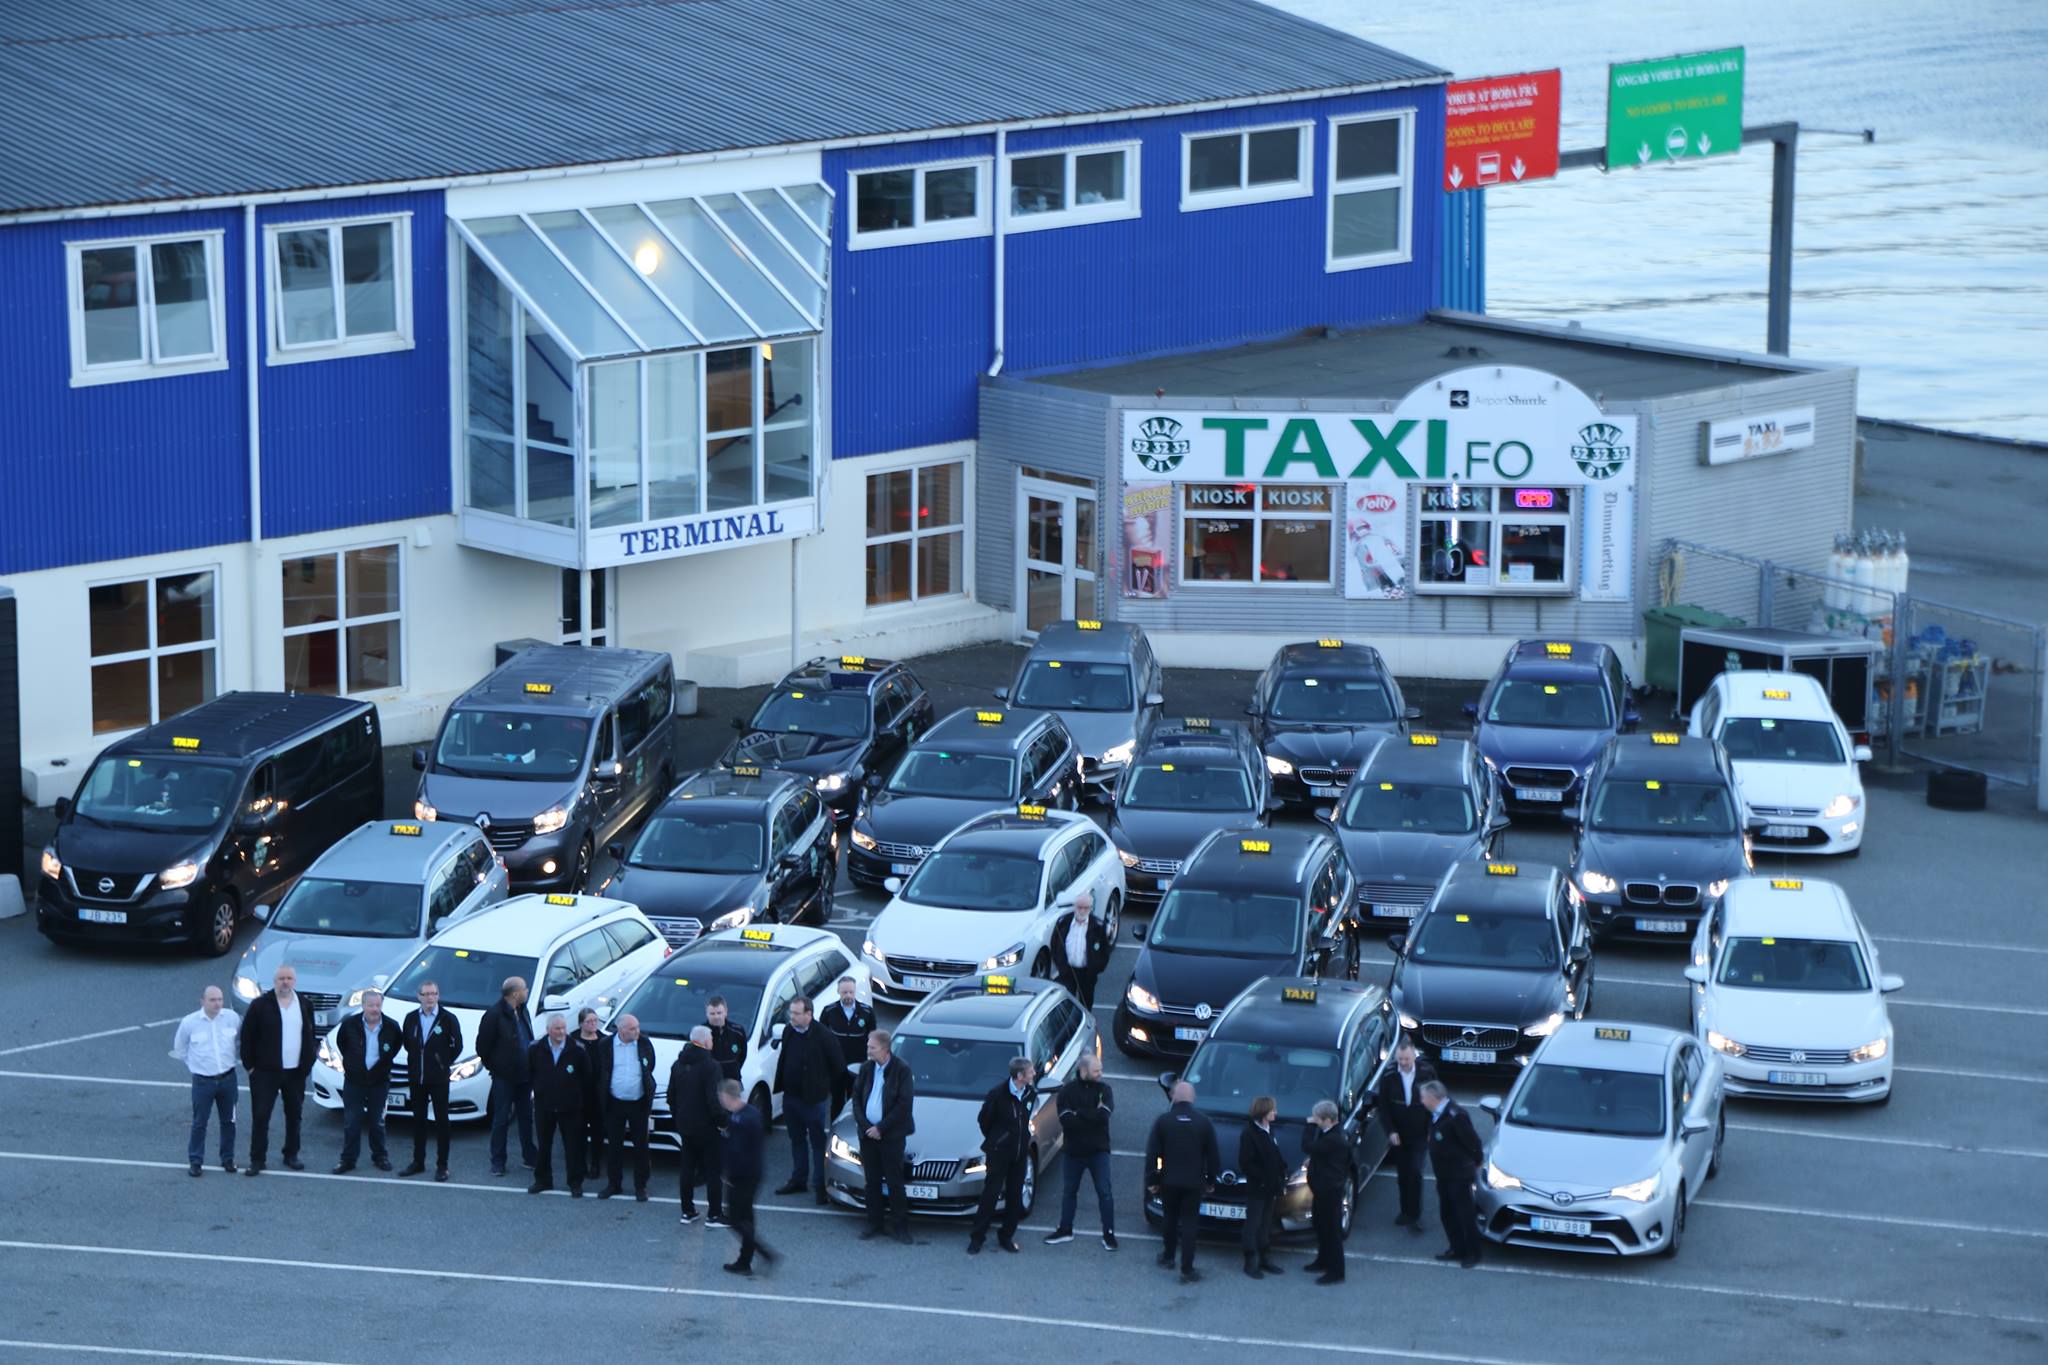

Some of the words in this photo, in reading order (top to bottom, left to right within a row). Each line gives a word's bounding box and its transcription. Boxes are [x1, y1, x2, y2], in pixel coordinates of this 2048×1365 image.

[1477, 123, 1491, 135] TO
[1139, 417, 1183, 441] TAXI
[1747, 420, 1776, 437] TAXI
[1580, 424, 1622, 446] TAXI
[1132, 440, 1149, 453] 32
[1153, 441, 1169, 454] 32
[1172, 440, 1189, 453] 32
[1572, 447, 1589, 460] 32
[1592, 448, 1609, 461] 32
[1612, 447, 1629, 460] 32
[1146, 458, 1176, 473] BIL
[1585, 465, 1616, 480] BIL
[1191, 489, 1247, 505] KIOSK
[1267, 490, 1325, 506] KIOSK
[1362, 496, 1393, 512] Jolly
[620, 511, 784, 556] TERMINAL
[1077, 620, 1102, 629] TAXI
[1546, 643, 1571, 653] TAXI
[842, 656, 865, 664] TAXI
[526, 683, 551, 692] TAXI
[1764, 691, 1789, 699] TAXI
[977, 712, 1002, 721] TAXI
[1185, 718, 1210, 726] TAXI
[173, 737, 199, 747] TAXI
[1410, 735, 1437, 744] TAXI
[1652, 733, 1679, 744] TAXI
[735, 766, 759, 775] TAXI
[1019, 804, 1046, 815] TAXI
[394, 825, 420, 834] TAXI
[1242, 840, 1269, 852] TAXI
[1488, 864, 1516, 874] TAXI
[1773, 880, 1801, 889] TAXI
[548, 895, 573, 905] TAXI
[744, 930, 771, 940] TAXI
[914, 976, 926, 988] TK
[1286, 989, 1315, 999] TAXI
[1599, 1029, 1628, 1039] TAXI
[1452, 1051, 1465, 1061] BJ
[912, 1186, 934, 1198] 652
[1209, 1205, 1224, 1217] HV
[1543, 1220, 1558, 1231] DV
